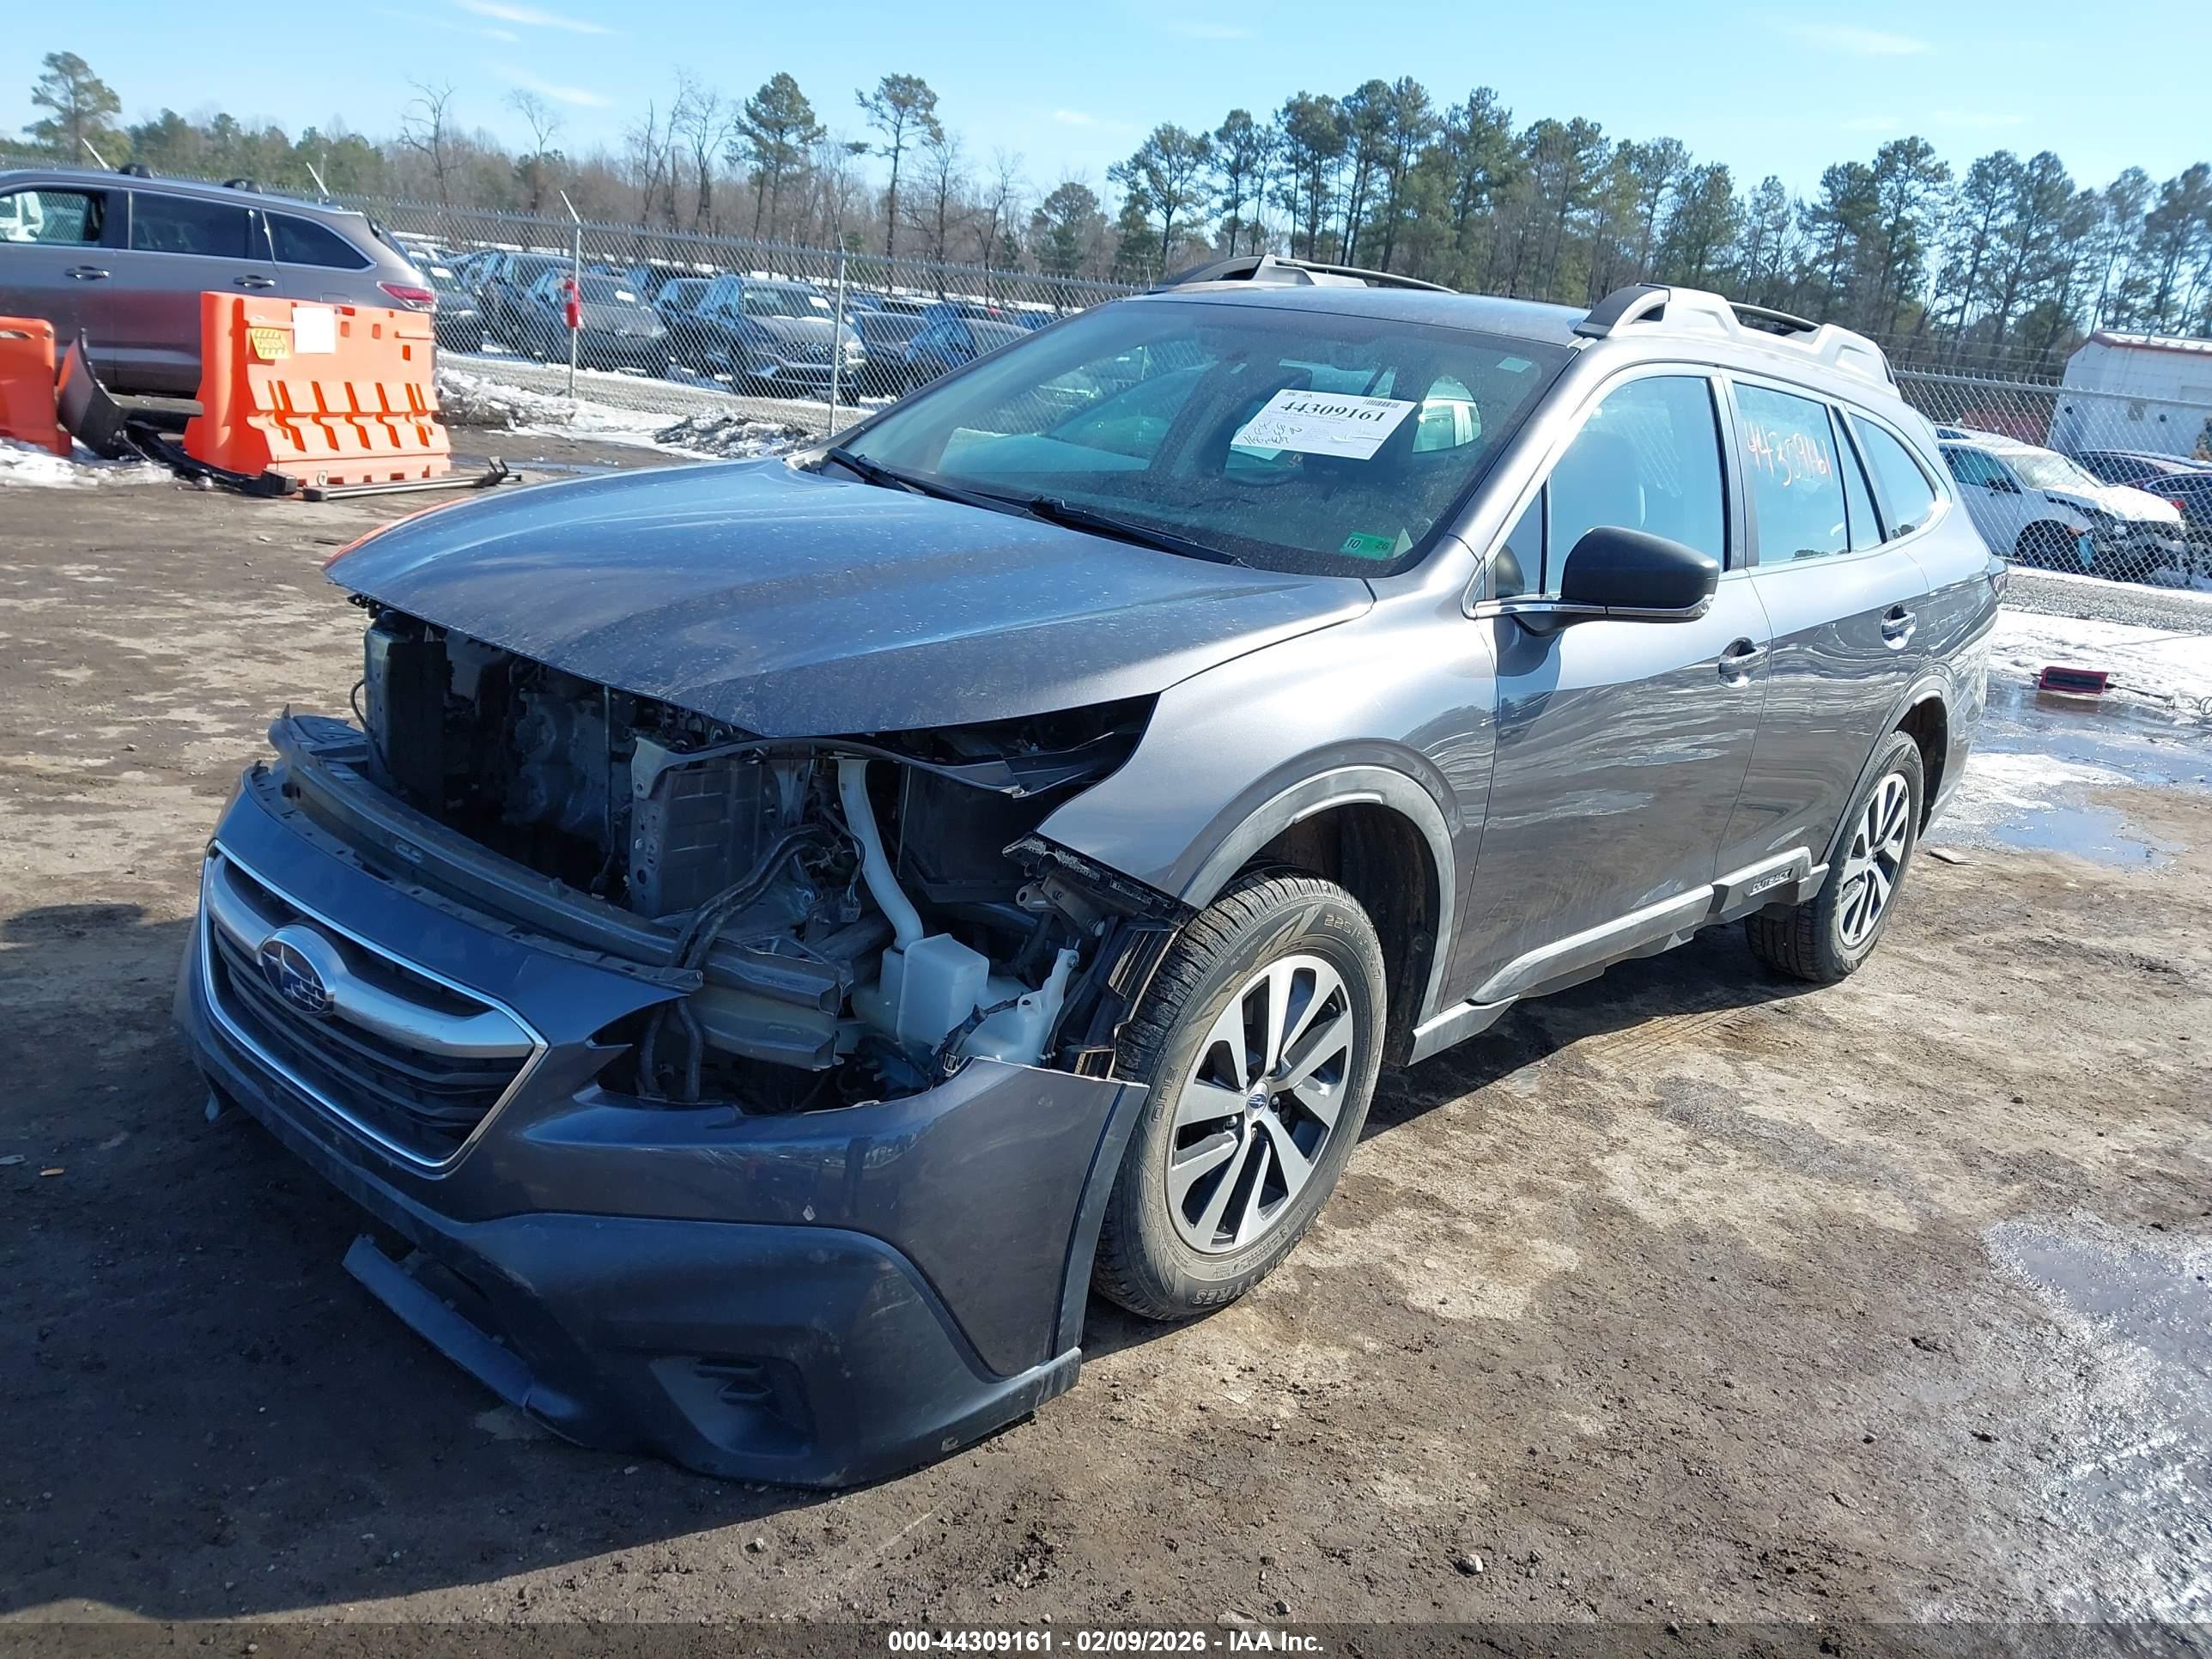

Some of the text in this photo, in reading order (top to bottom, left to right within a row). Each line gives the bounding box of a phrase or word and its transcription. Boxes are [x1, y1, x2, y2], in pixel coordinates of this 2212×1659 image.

[1280, 400, 1387, 422] 44309161
[1346, 538, 1361, 549] 10
[1151, 1065, 1179, 1123] ONE
[1192, 1275, 1258, 1305] TYRES
